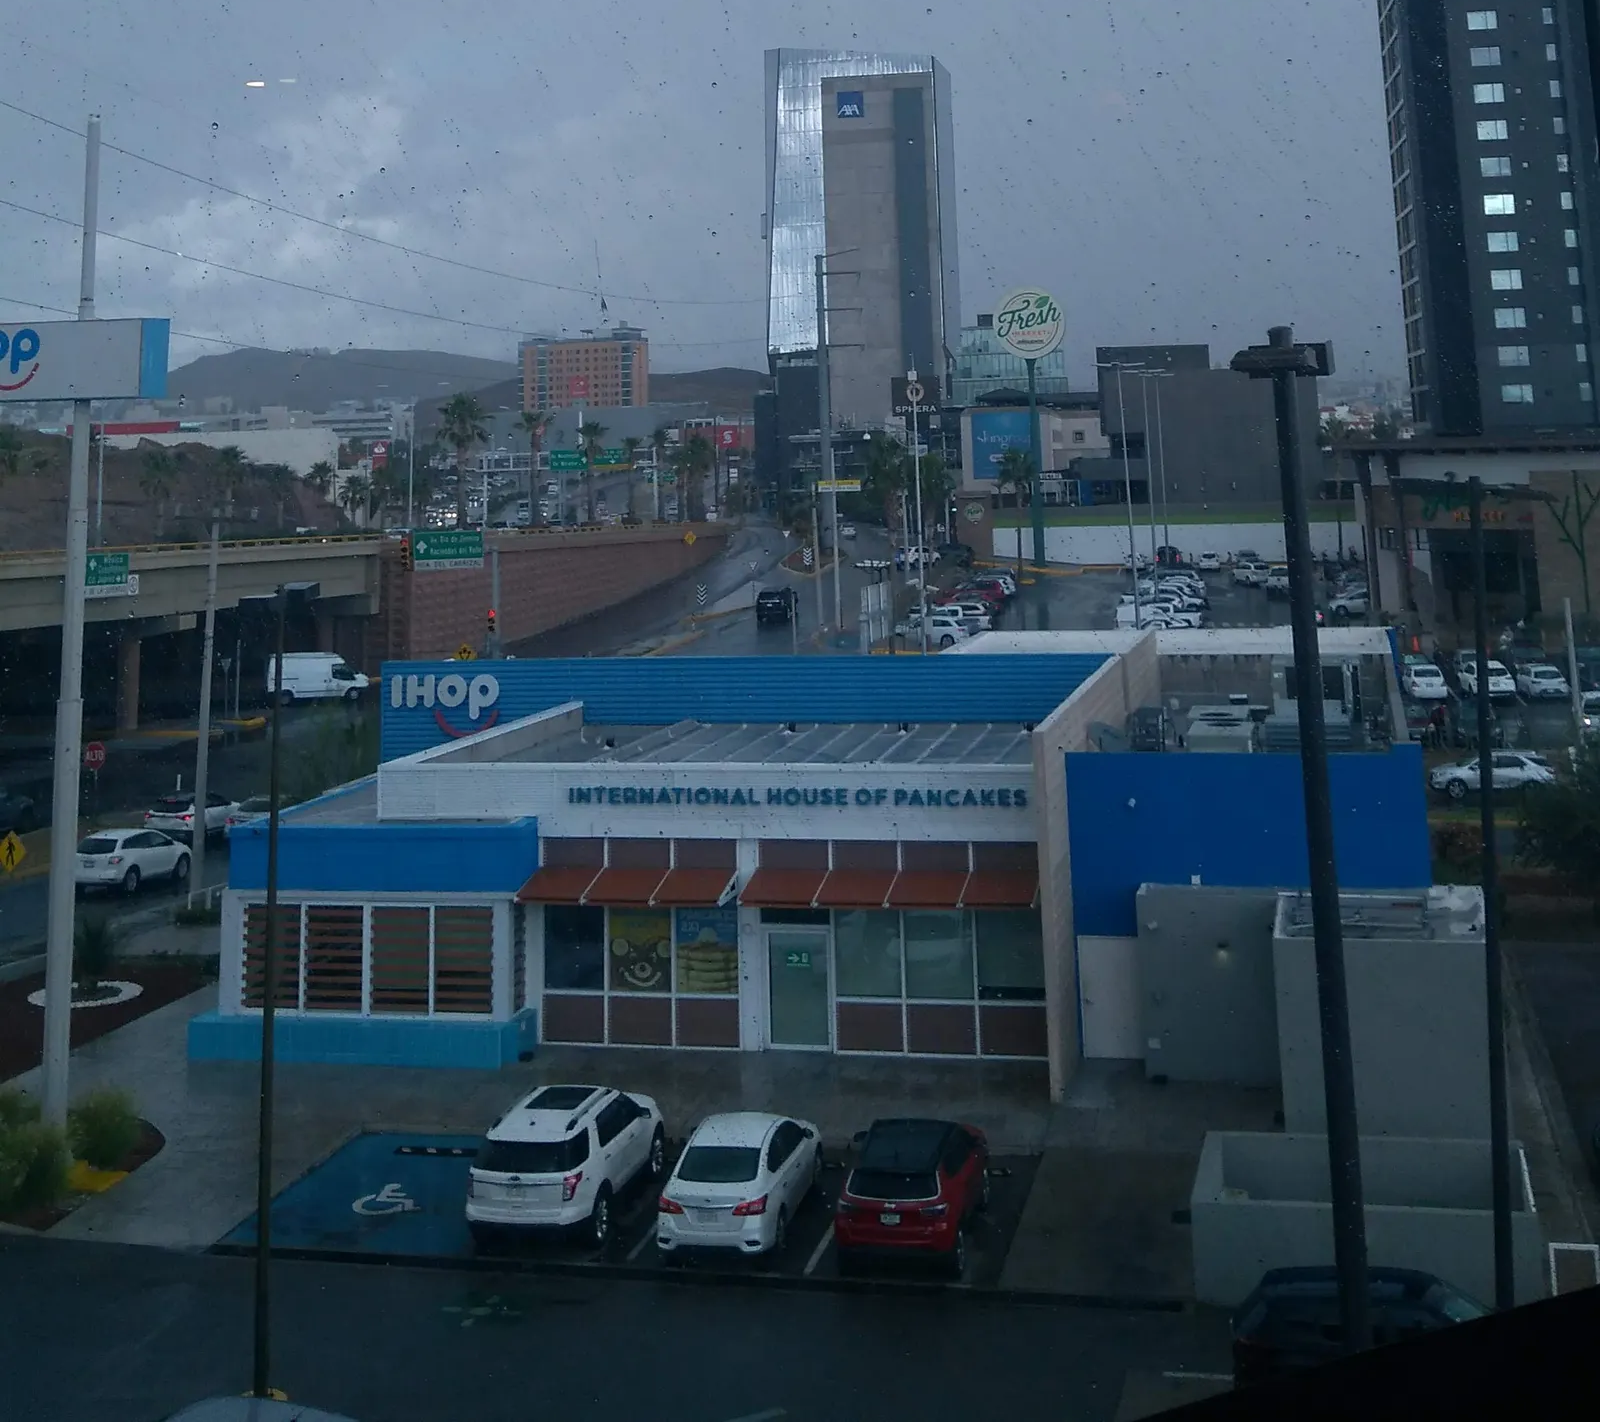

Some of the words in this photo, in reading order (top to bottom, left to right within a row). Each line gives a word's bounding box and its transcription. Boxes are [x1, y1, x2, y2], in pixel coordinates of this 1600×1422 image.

[837, 104, 860, 116] AXA
[997, 299, 1061, 338] Fresh
[895, 405, 937, 413] SPHERA
[391, 673, 500, 720] IHOP
[86, 750, 105, 761] ALTO
[568, 786, 761, 805] INTERNATIONAL
[766, 786, 849, 806] HOUSE
[855, 788, 888, 806] OF
[895, 788, 1028, 808] PANCAKES
